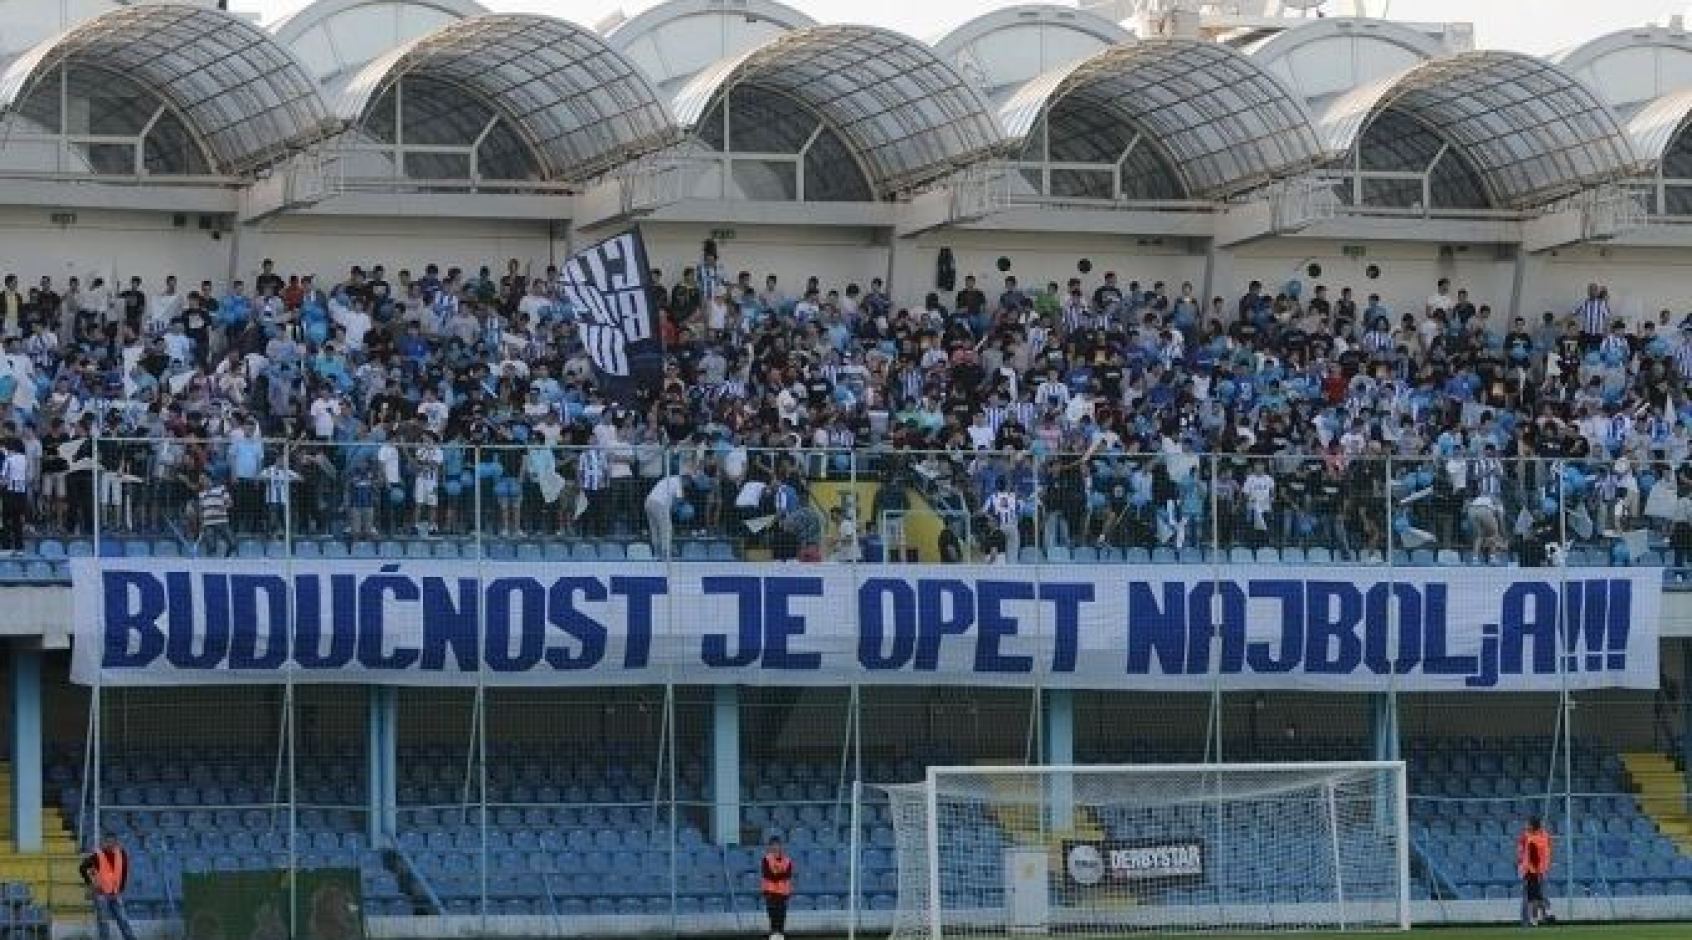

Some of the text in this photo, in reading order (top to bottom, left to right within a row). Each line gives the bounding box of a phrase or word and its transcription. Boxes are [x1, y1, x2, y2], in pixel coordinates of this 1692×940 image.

[101, 564, 668, 672] BUDUĆNOST
[701, 576, 824, 669] JE
[858, 578, 1096, 672] OPET
[1110, 845, 1200, 869] DERBYSTAR
